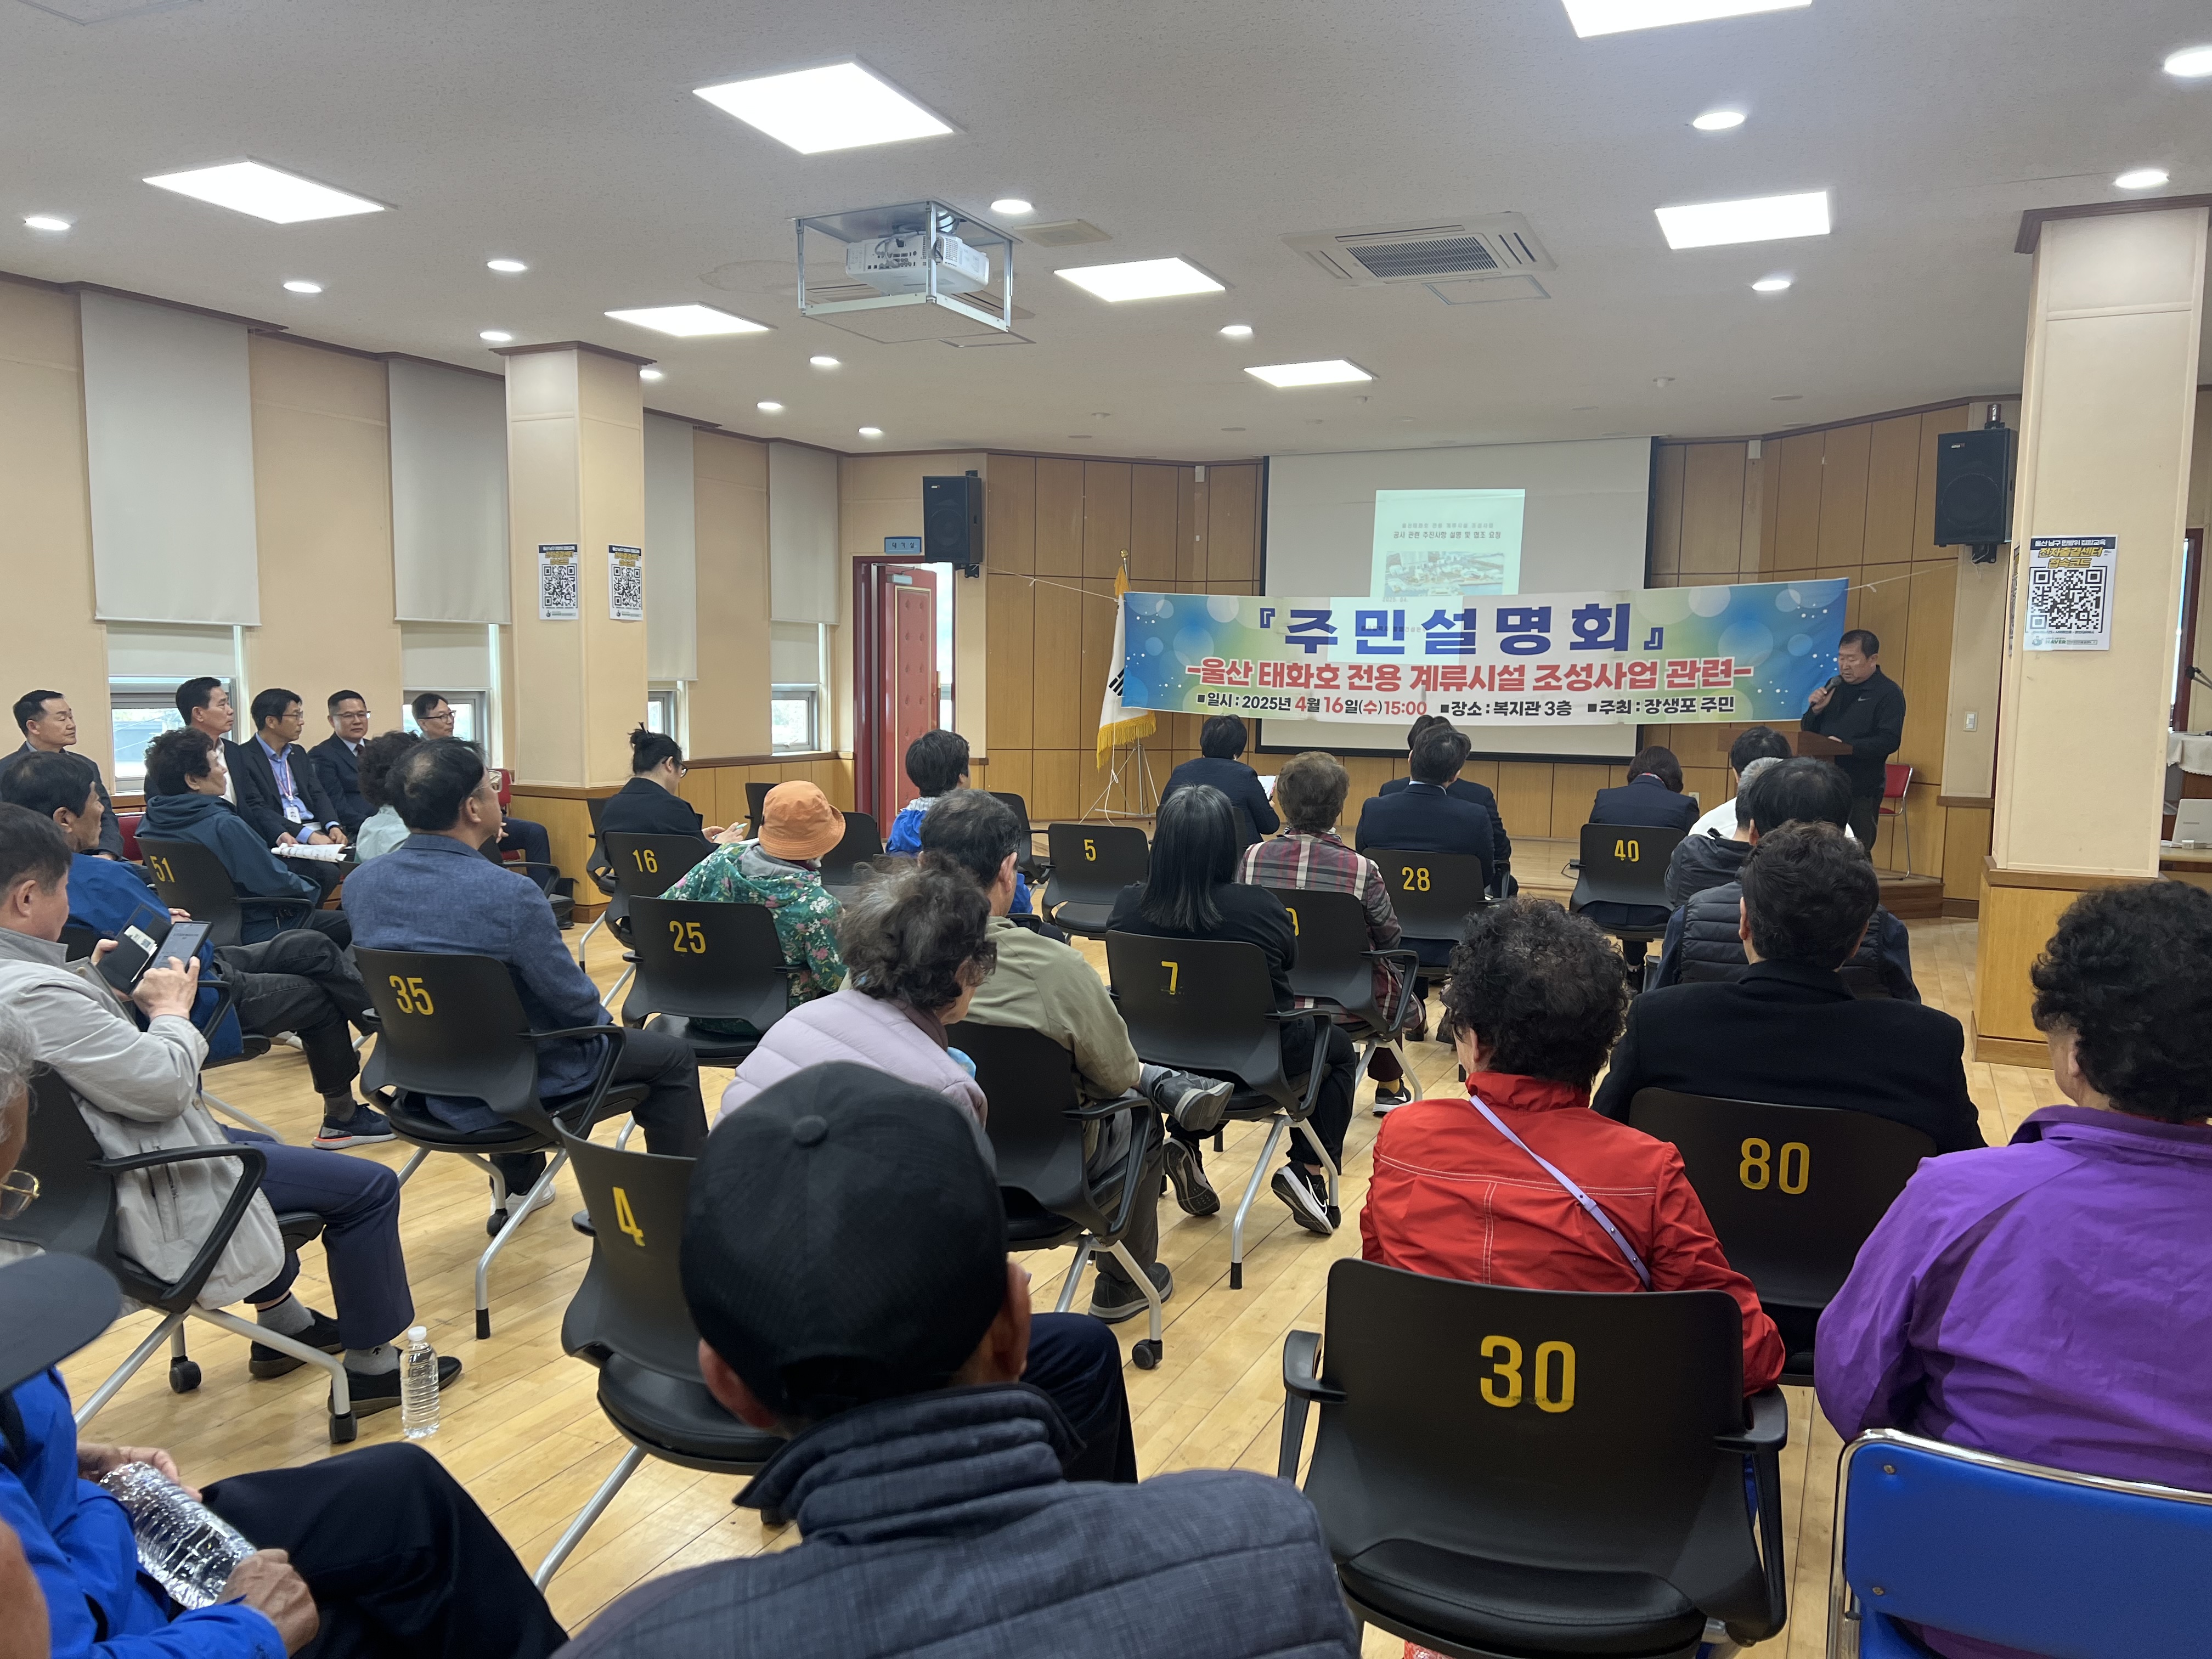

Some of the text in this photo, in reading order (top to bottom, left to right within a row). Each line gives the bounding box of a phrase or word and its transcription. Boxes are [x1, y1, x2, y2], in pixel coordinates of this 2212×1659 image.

[1259, 662, 1340, 690] 태화호
[1347, 664, 1402, 692] 전용
[1409, 664, 1526, 692] 계류시설
[1532, 662, 1658, 691] 조성사업
[1295, 696, 1321, 713] 4월
[1493, 701, 1541, 716] 복지관
[1544, 701, 1572, 716] 3층
[1645, 697, 1696, 714] 장생포
[1701, 696, 1734, 713] 주민
[633, 849, 658, 873] 16
[1084, 839, 1097, 861] 5
[1615, 840, 1639, 862] 40
[149, 855, 176, 883] 51
[1402, 867, 1431, 891] 28
[669, 921, 706, 953] 25
[1161, 961, 1178, 995] 7
[389, 975, 434, 1015] 35
[1739, 1137, 1810, 1194] 80
[612, 1186, 646, 1246] 4
[1480, 1335, 1576, 1413] 30
